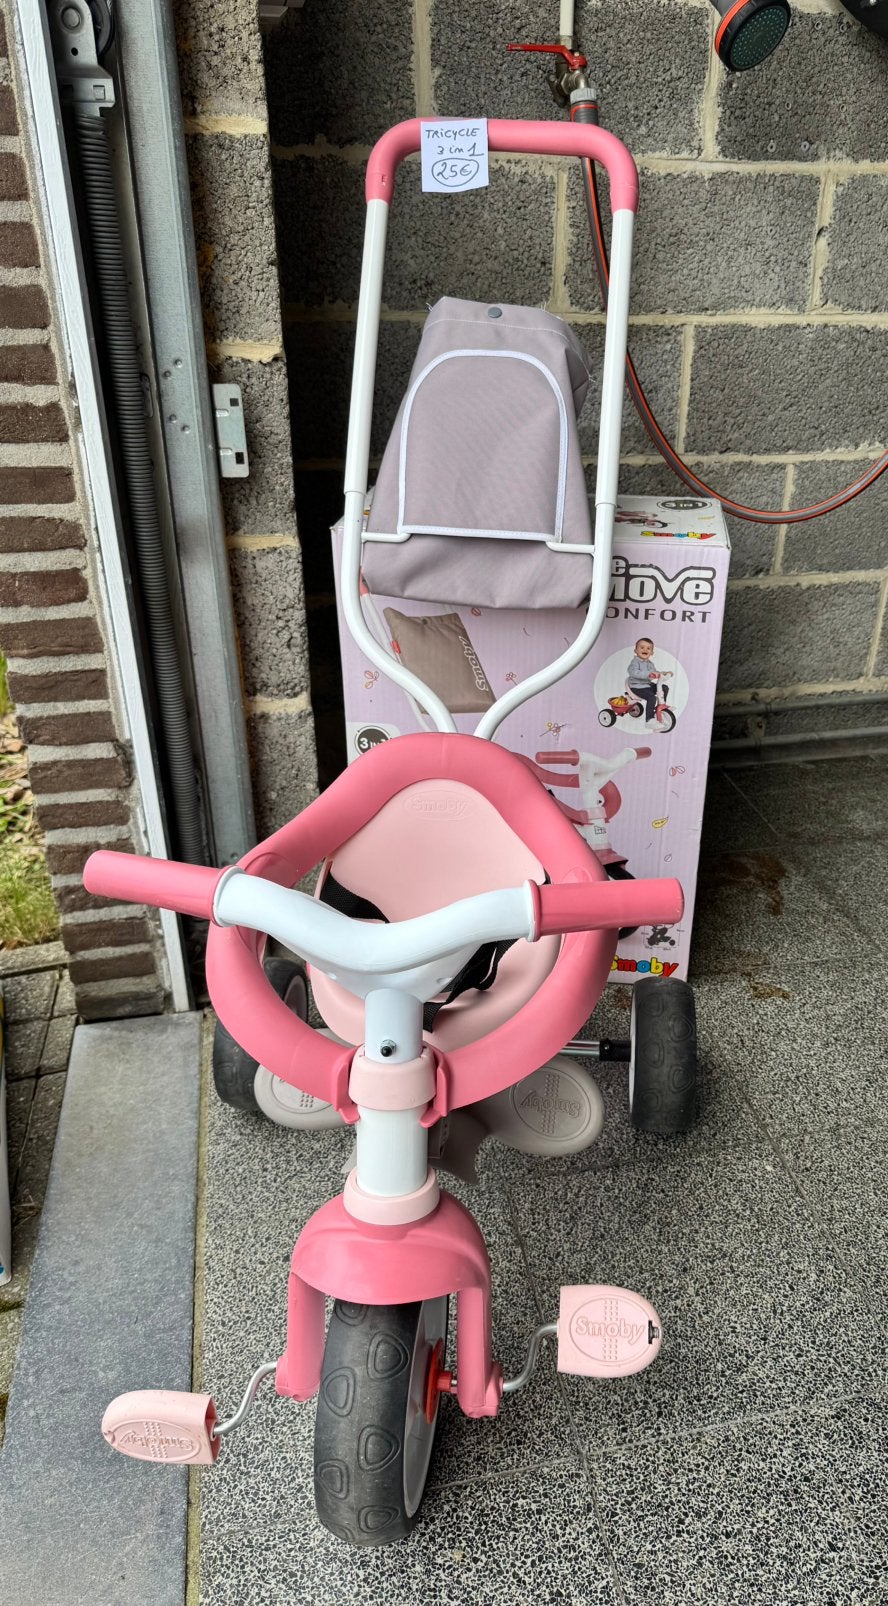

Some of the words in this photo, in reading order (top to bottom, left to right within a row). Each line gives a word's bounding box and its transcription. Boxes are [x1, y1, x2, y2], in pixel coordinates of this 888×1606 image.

[436, 145, 445, 155] 3
[465, 142, 484, 157] 1
[436, 161, 473, 180] 25€
[586, 606, 711, 623] ONFORT
[458, 635, 489, 692] Smoby
[359, 737, 369, 749] 3
[520, 1088, 582, 1119] Smoby
[575, 1315, 645, 1345] Smoby
[119, 1429, 194, 1451] Smoby
